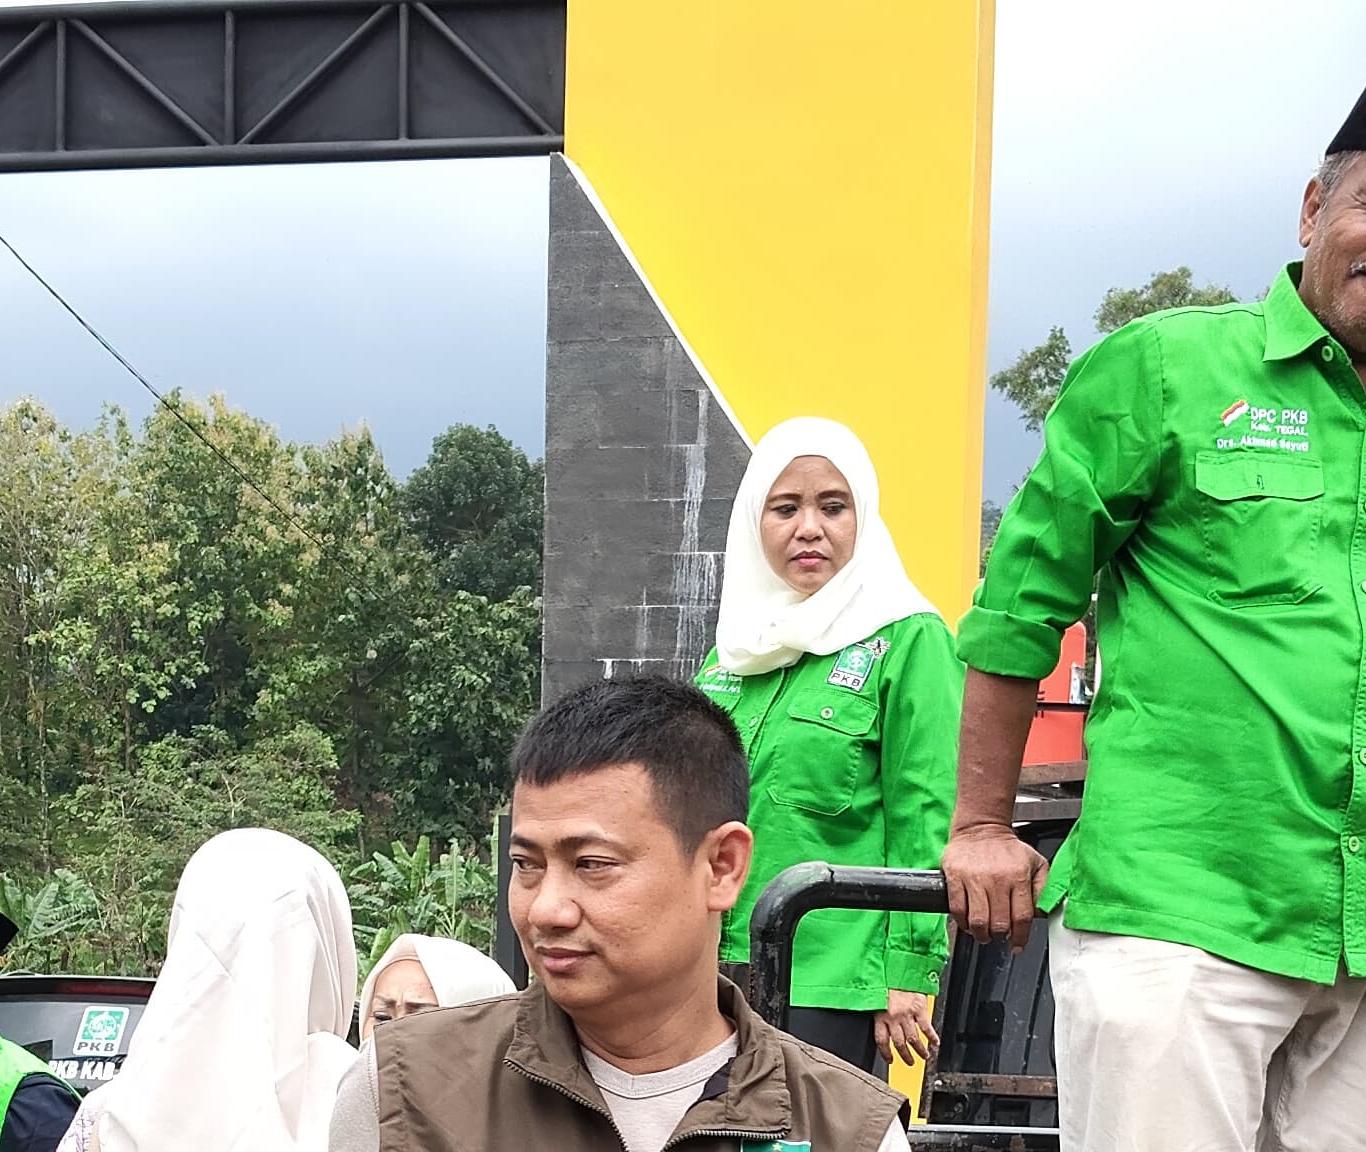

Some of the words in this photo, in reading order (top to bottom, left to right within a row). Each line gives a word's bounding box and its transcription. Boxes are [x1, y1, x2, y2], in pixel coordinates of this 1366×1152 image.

[1250, 407, 1277, 424] DPC
[1281, 409, 1308, 425] PKB
[831, 672, 862, 688] PKB
[76, 1041, 115, 1052] PKB
[48, 1060, 79, 1080] PKB
